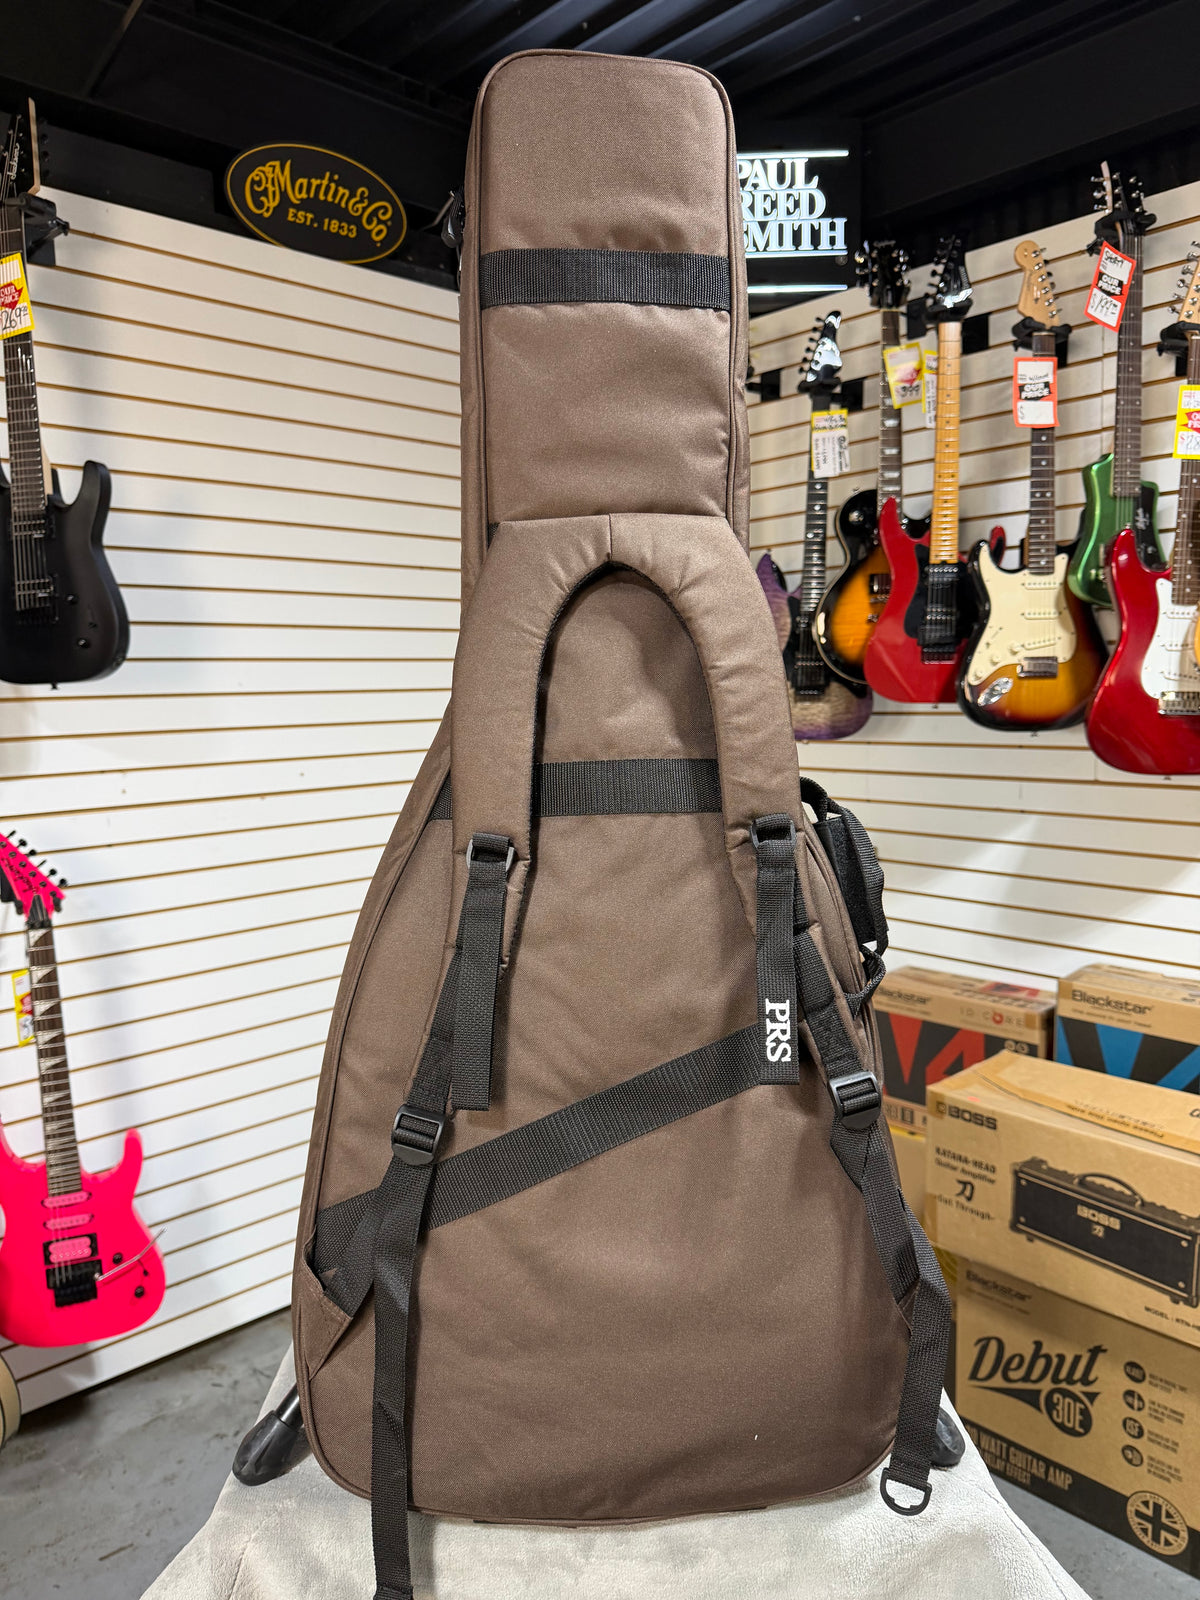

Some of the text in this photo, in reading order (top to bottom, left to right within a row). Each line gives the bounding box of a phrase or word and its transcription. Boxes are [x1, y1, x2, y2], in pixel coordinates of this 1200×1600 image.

[287, 207, 358, 238] EST. 1833
[743, 217, 848, 252] MITH
[0, 285, 15, 297] OUR
[1098, 280, 1122, 296] PRICE
[1102, 274, 1119, 286] OUR
[1020, 388, 1050, 400] PRICE
[1023, 382, 1045, 392] OUR
[1071, 988, 1153, 1015] Blackstar
[765, 998, 792, 1063] PRS
[947, 1104, 998, 1131] BOSS
[1076, 1204, 1121, 1231] BOSS
[968, 1336, 1109, 1386] Debut
[1051, 1391, 1086, 1435] 30E
[1008, 1446, 1047, 1480] GUITAR
[1047, 1466, 1074, 1492] AMP
